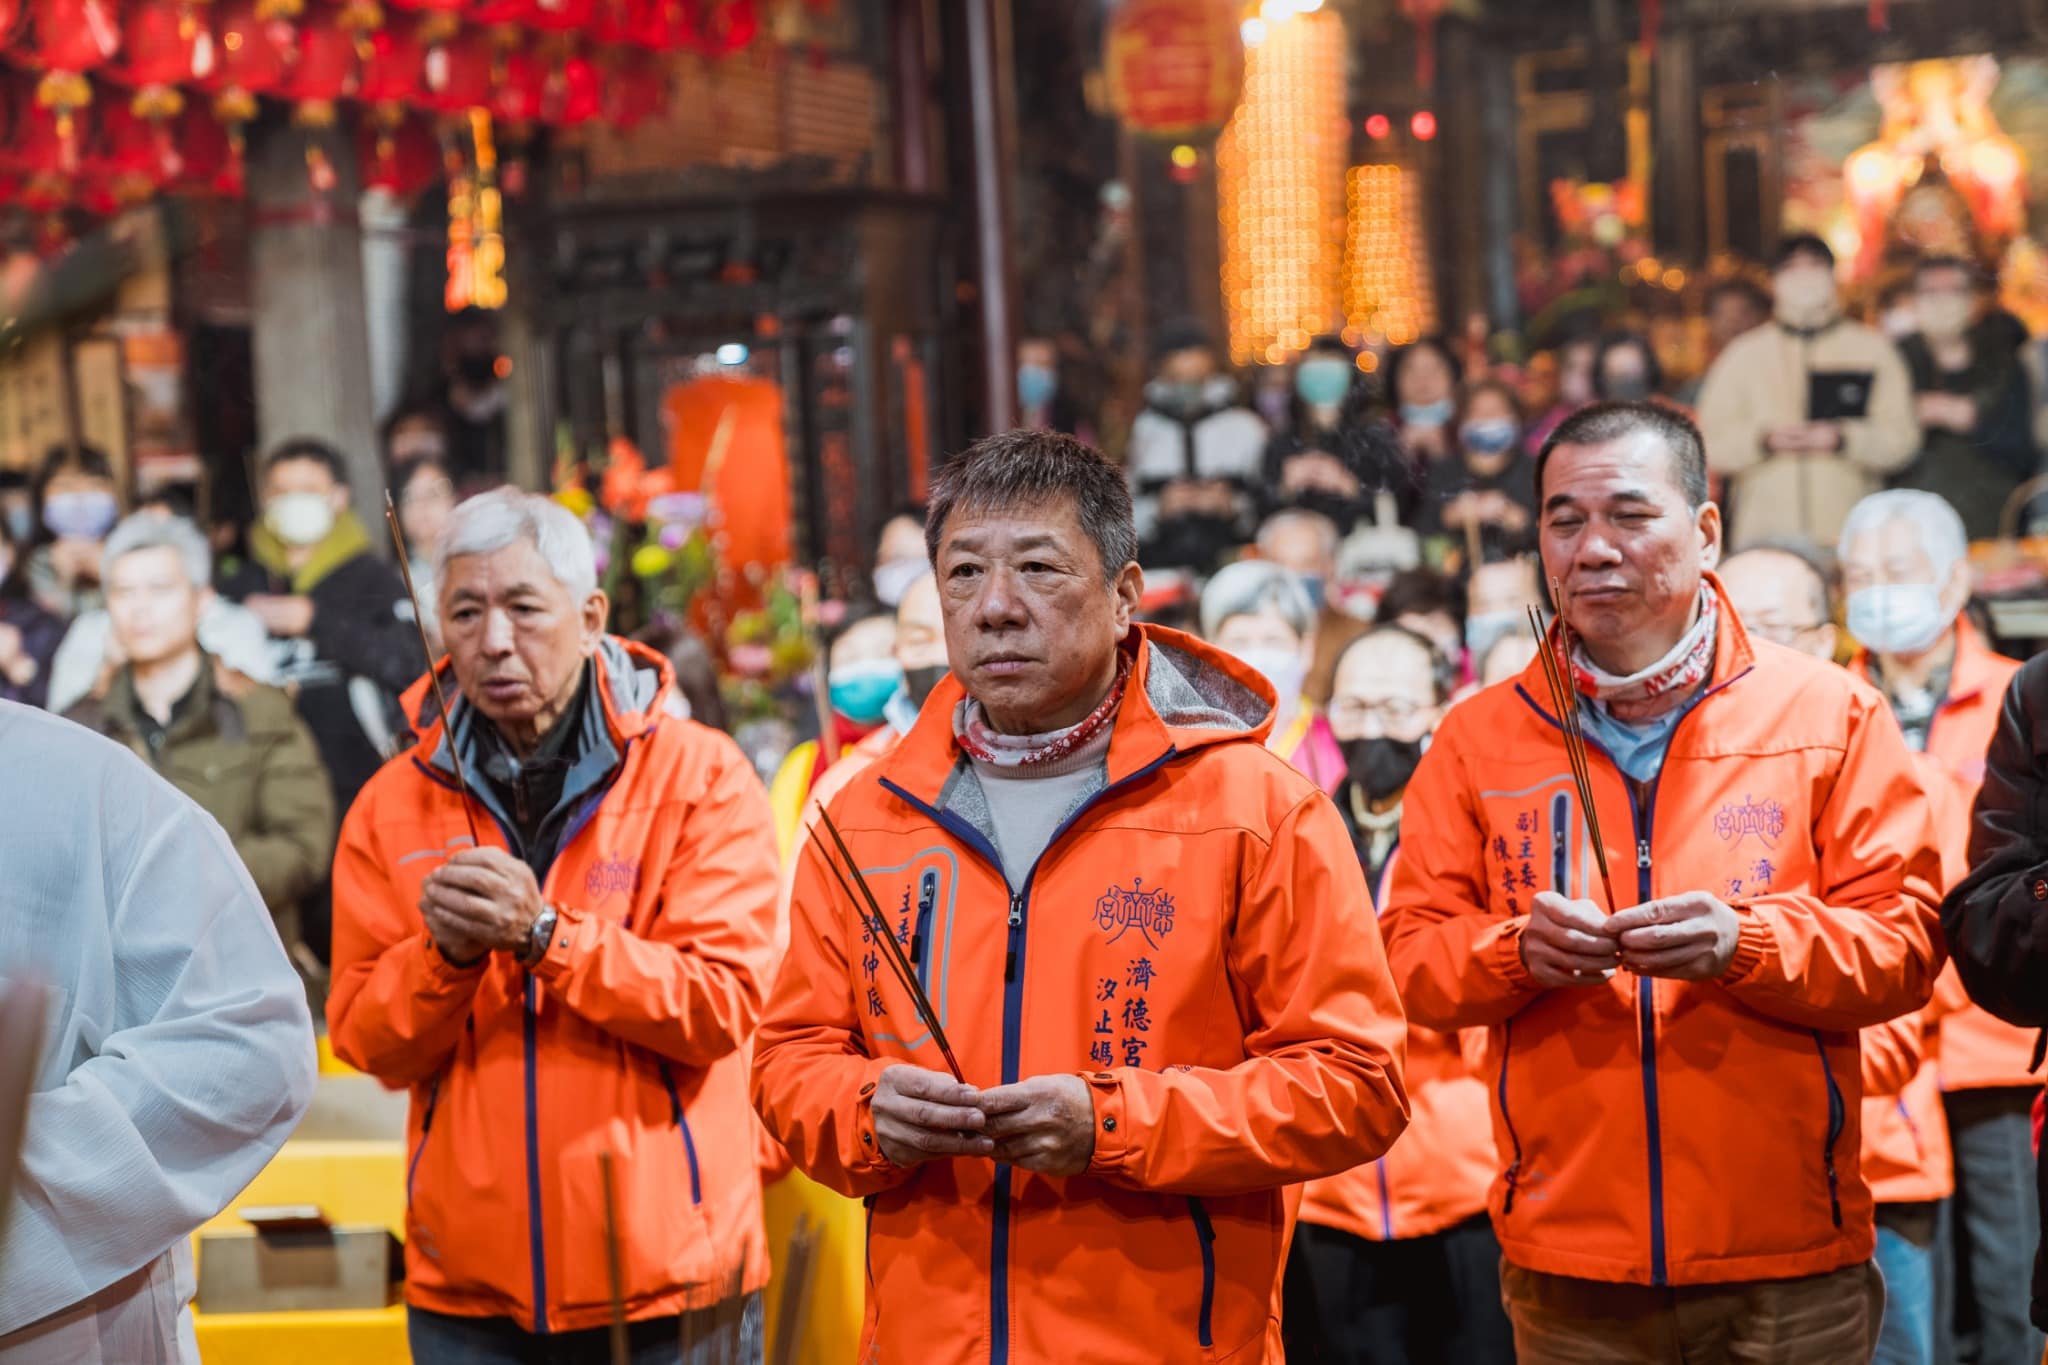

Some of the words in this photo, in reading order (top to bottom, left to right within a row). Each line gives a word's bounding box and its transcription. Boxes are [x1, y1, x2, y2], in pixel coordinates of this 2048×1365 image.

[1089, 977, 1119, 1067] 汐止媽
[1121, 957, 1158, 1068] 濟德宮
